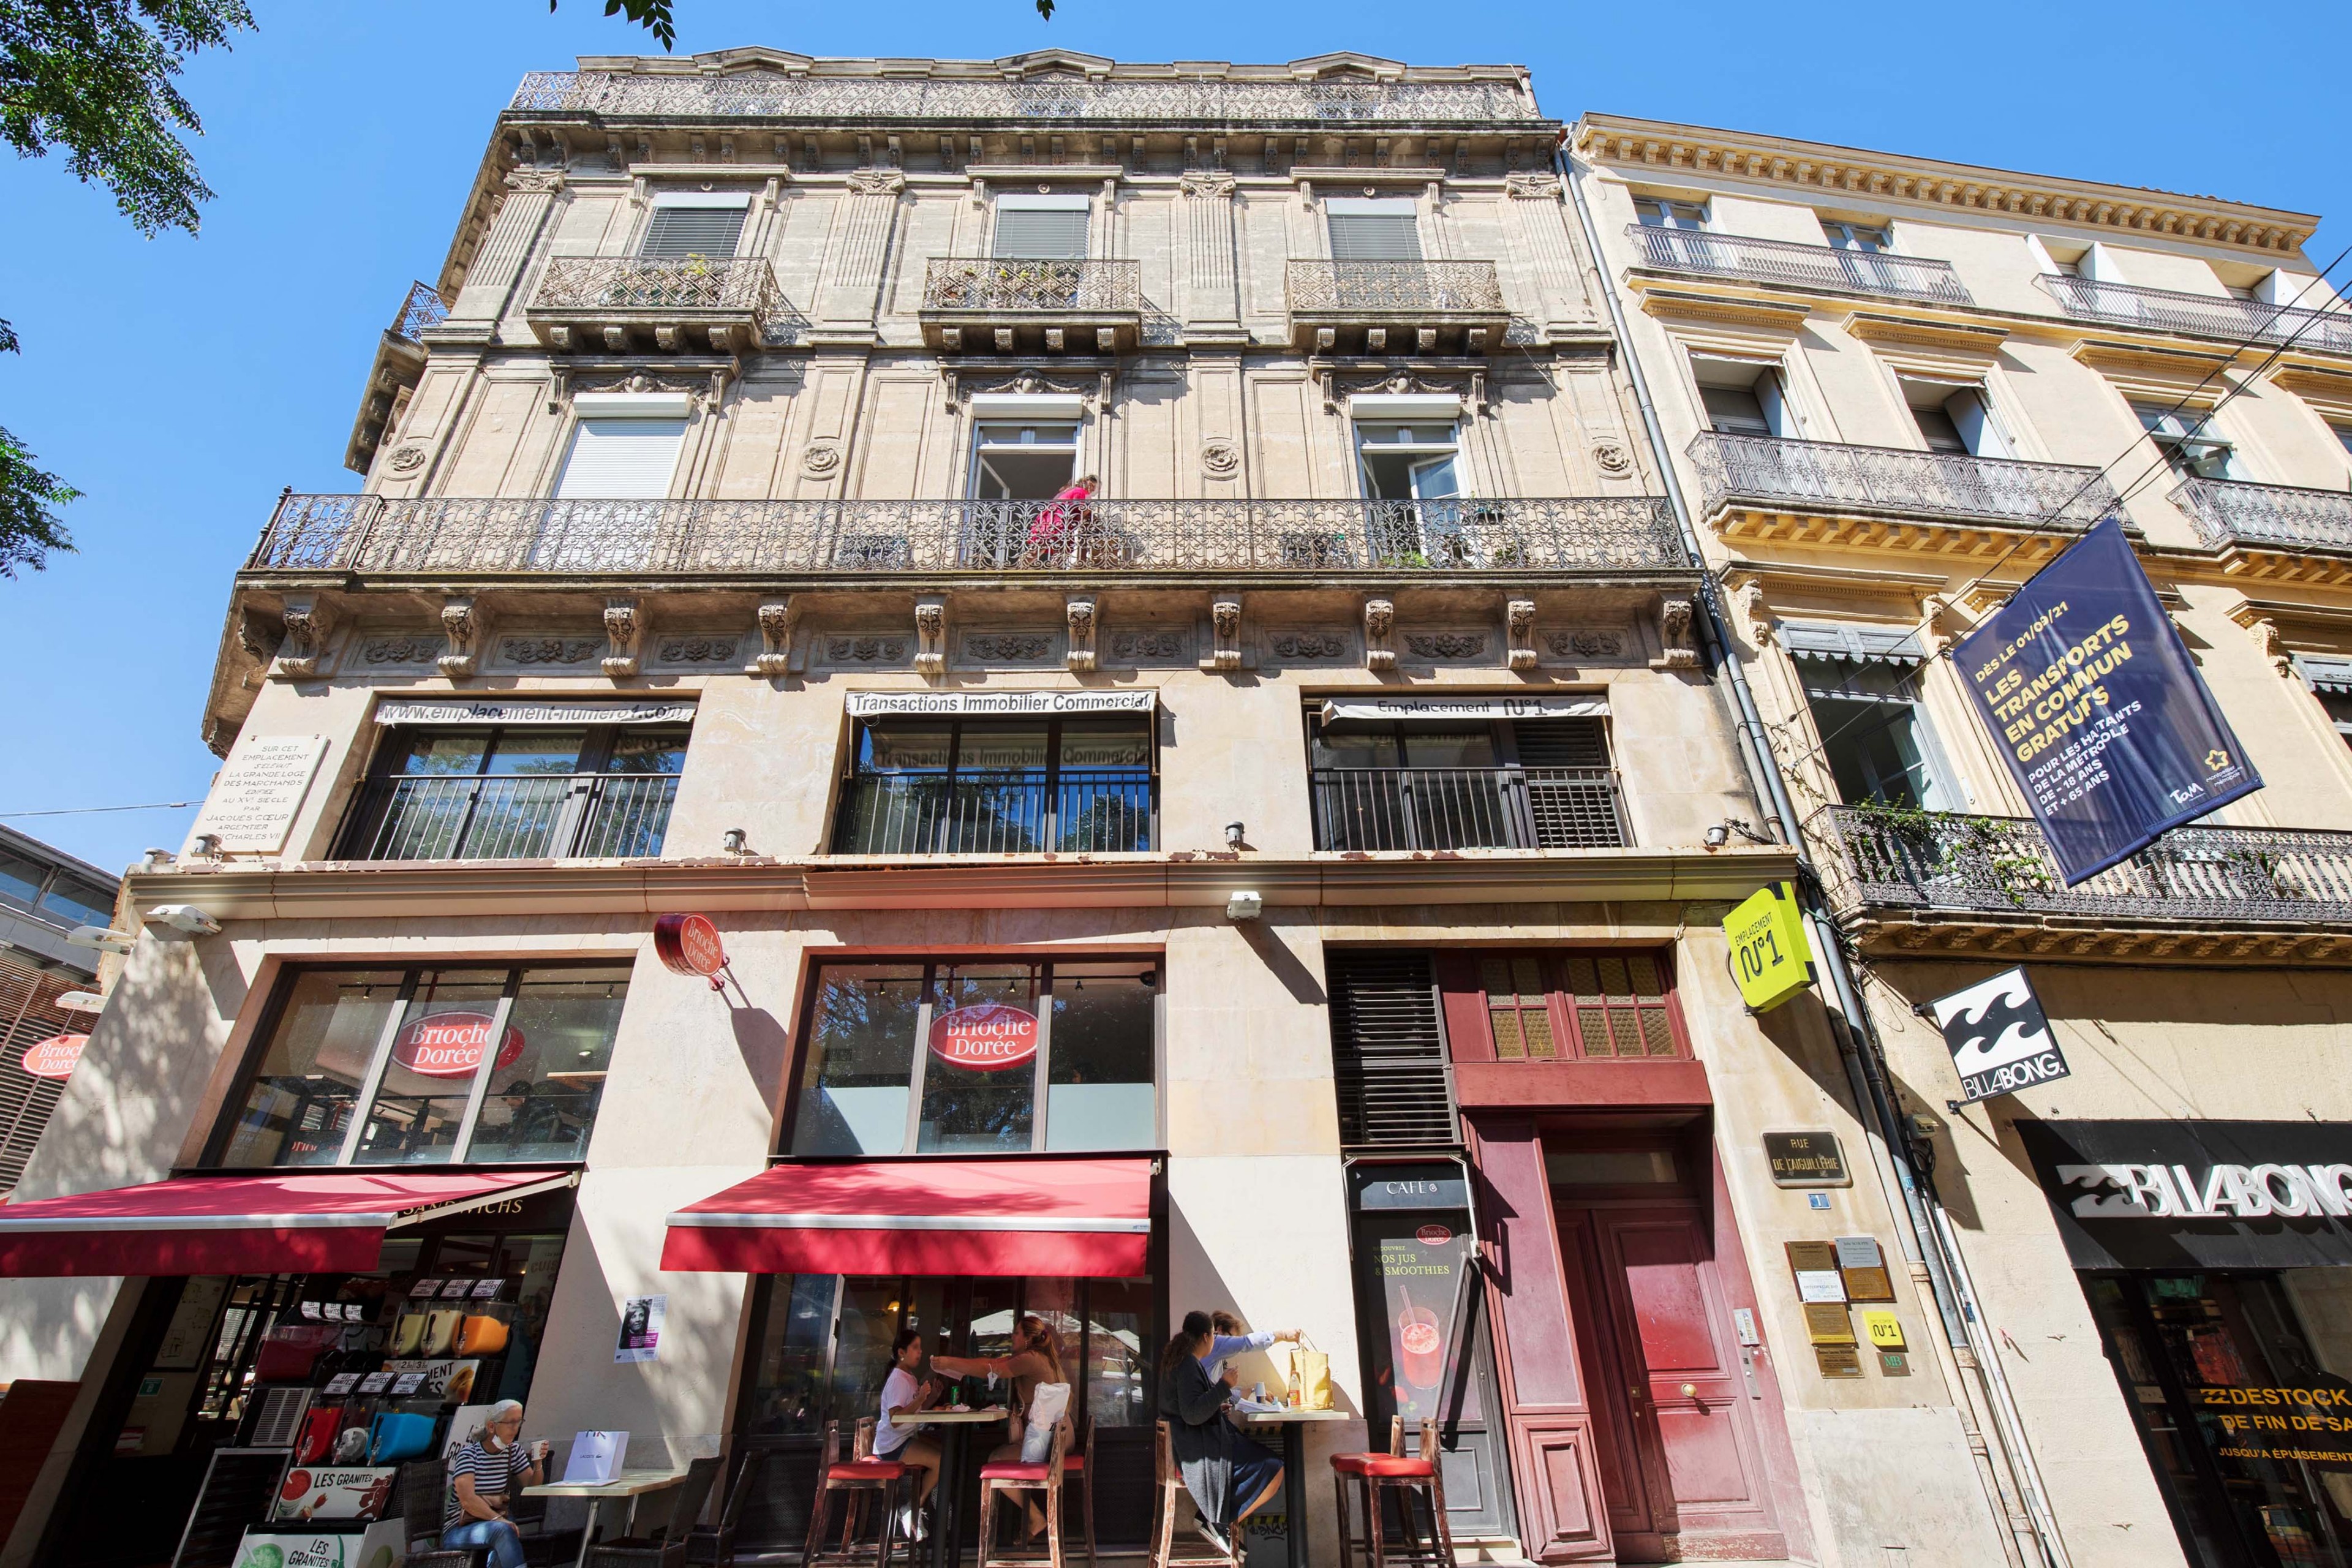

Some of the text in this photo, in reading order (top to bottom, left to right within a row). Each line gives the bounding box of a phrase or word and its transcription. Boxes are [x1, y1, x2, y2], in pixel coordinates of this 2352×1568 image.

[1975, 601, 2069, 683] DÈS LE 01/09/21
[1994, 614, 2130, 723] TRANSPORTS
[1985, 668, 2022, 705] LES
[2005, 641, 2133, 744] EN COMMUN
[854, 693, 1150, 711] Transactions Immobilier Commercial
[1378, 701, 1491, 715] Emplacement
[2028, 757, 2060, 784] POUR
[2060, 742, 2081, 762] LES
[2034, 778, 2050, 794] DE
[2049, 769, 2066, 784] LA
[2039, 789, 2056, 805] DE
[2063, 776, 2076, 789] 18
[2078, 759, 2103, 782] ANS
[2045, 801, 2059, 816] ET
[2068, 787, 2082, 801] 65
[2085, 770, 2109, 792] ANS
[687, 918, 718, 959] Brioche
[1735, 911, 1773, 946] EMPLACEMENT
[687, 941, 711, 971] Dorée
[947, 1013, 1031, 1036] Brioche
[413, 1042, 479, 1065] Dorée
[954, 1035, 1017, 1056] Dorée
[1790, 1139, 1810, 1148] RUE
[1773, 1157, 1839, 1170] DE L'AIGUILLERIE
[1374, 1254, 1416, 1265] NOS JUS
[1385, 1265, 1450, 1276] SMOOTHIES
[2222, 1415, 2250, 1430] DE
[2253, 1415, 2288, 1430] FIN
[2291, 1415, 2324, 1431] DE
[2219, 1447, 2271, 1458] JUSQU'A
[314, 1474, 335, 1488] LES
[309, 1539, 329, 1555] LES
